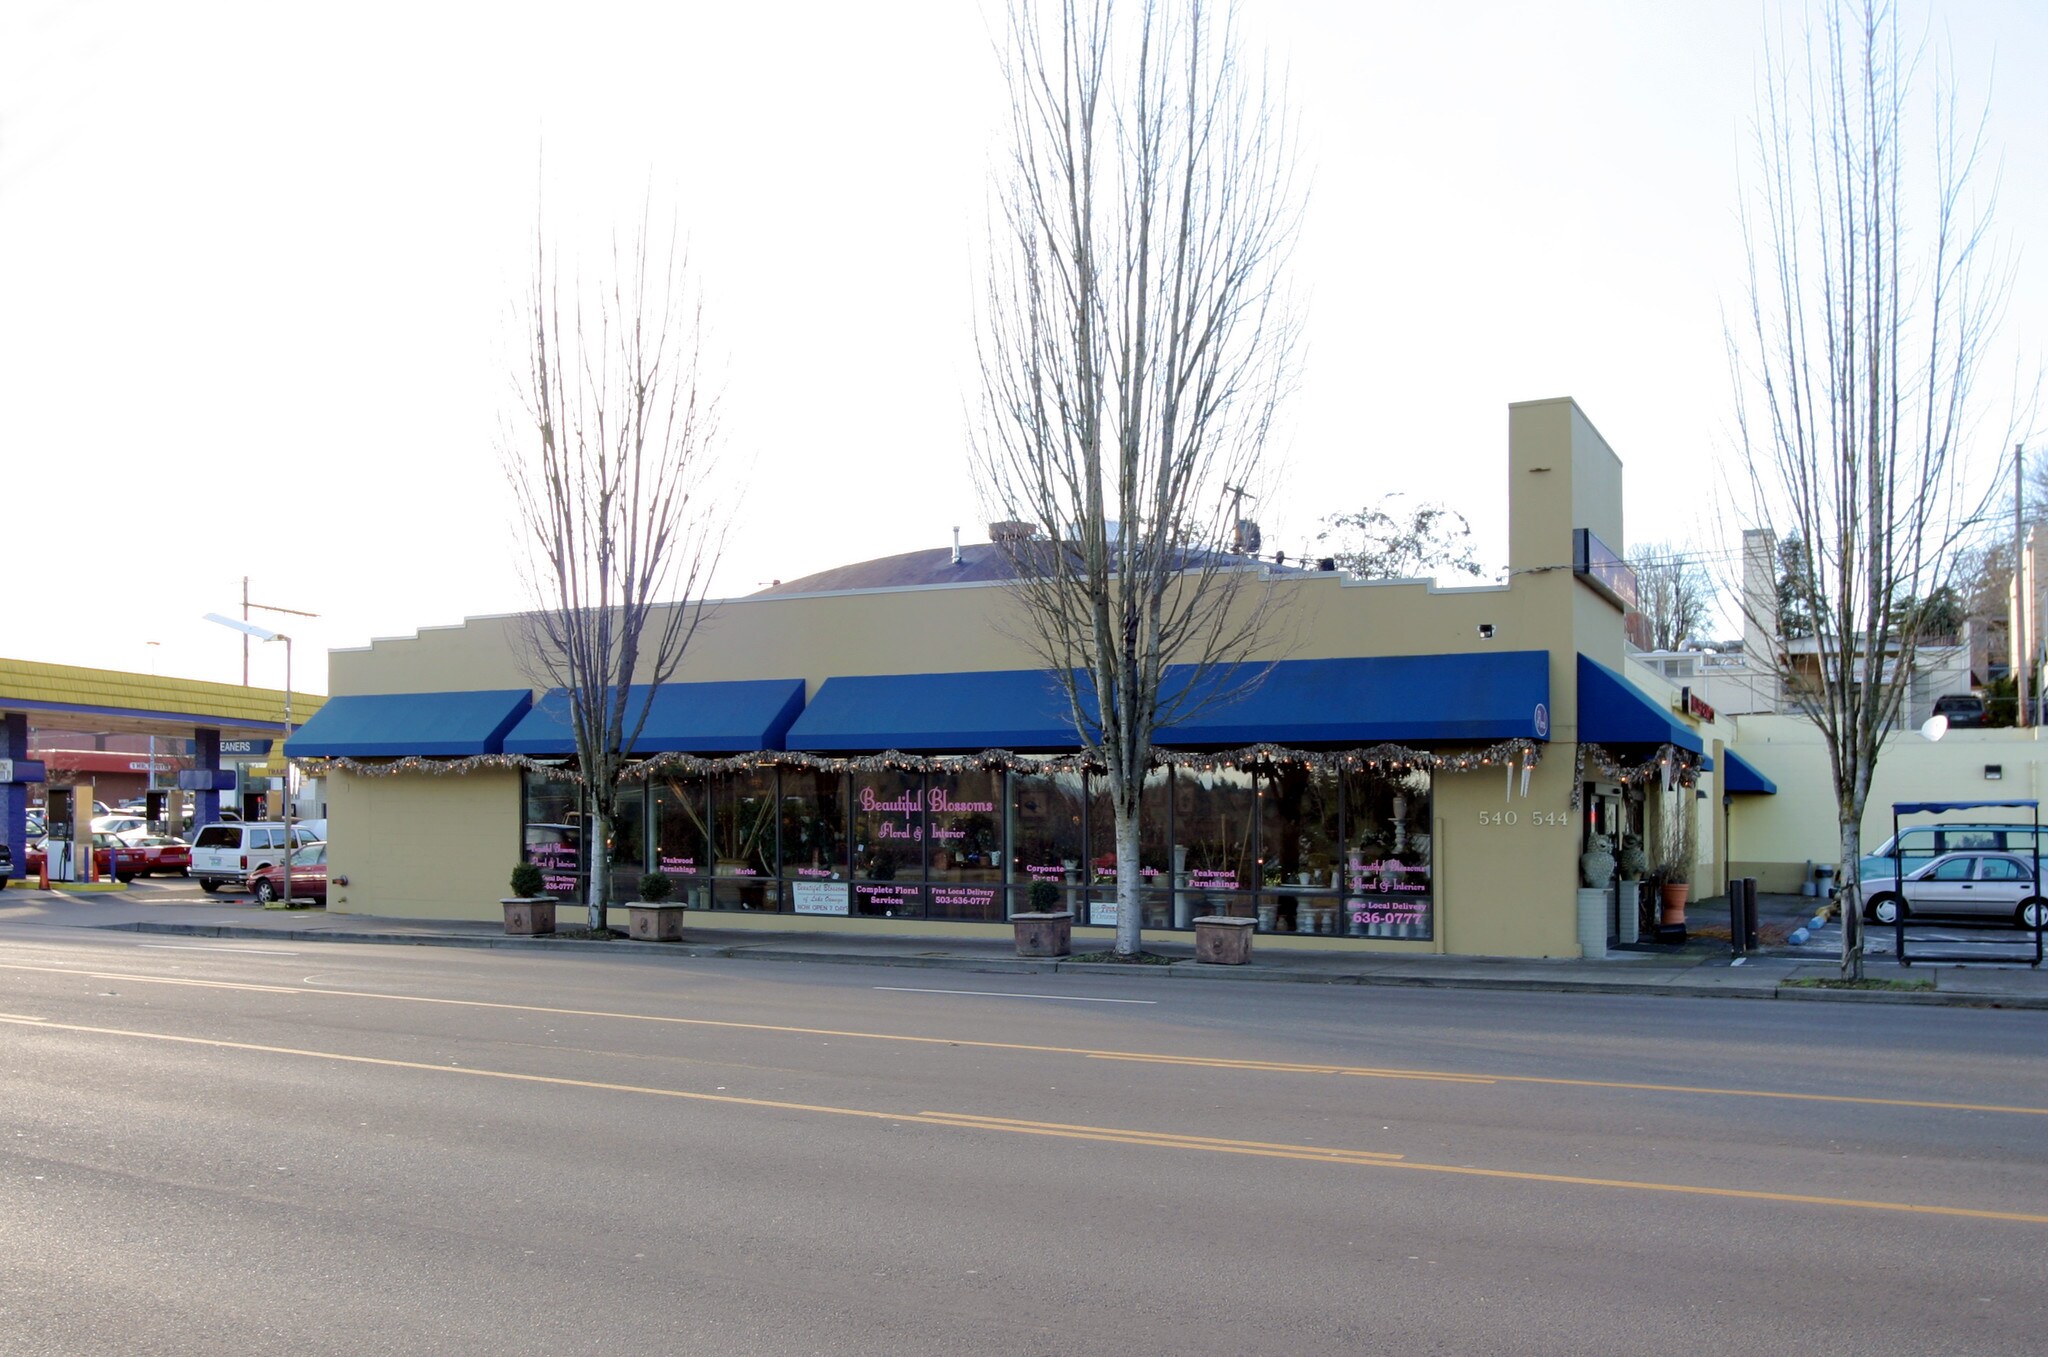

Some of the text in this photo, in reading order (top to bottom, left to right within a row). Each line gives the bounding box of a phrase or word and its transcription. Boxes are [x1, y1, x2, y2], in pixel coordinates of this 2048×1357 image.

[219, 741, 251, 752] EANERS
[860, 786, 993, 819] Beautiful Blossoms
[1479, 810, 1568, 826] 540 544
[878, 821, 966, 842] Floral & Interior
[662, 856, 694, 864] Teakwood
[659, 865, 697, 875] Furnishings
[1026, 864, 1065, 874] Corporate
[1097, 867, 1117, 875] Wate
[1349, 858, 1385, 875] Beautiful
[798, 868, 832, 877] Weddings
[1192, 869, 1236, 878] Teakwood
[544, 882, 575, 890] -636-0777
[1188, 880, 1240, 890] Furnishings
[1349, 875, 1377, 890] Floral
[1393, 878, 1426, 891] Interiors
[856, 886, 919, 895] Complete Floral
[966, 888, 995, 897] Delivery
[870, 896, 904, 905] Services
[935, 896, 992, 905] 503-636-0777
[1368, 901, 1391, 910] Local
[1392, 902, 1427, 912] Delivery
[1352, 912, 1424, 925] 636-0777
